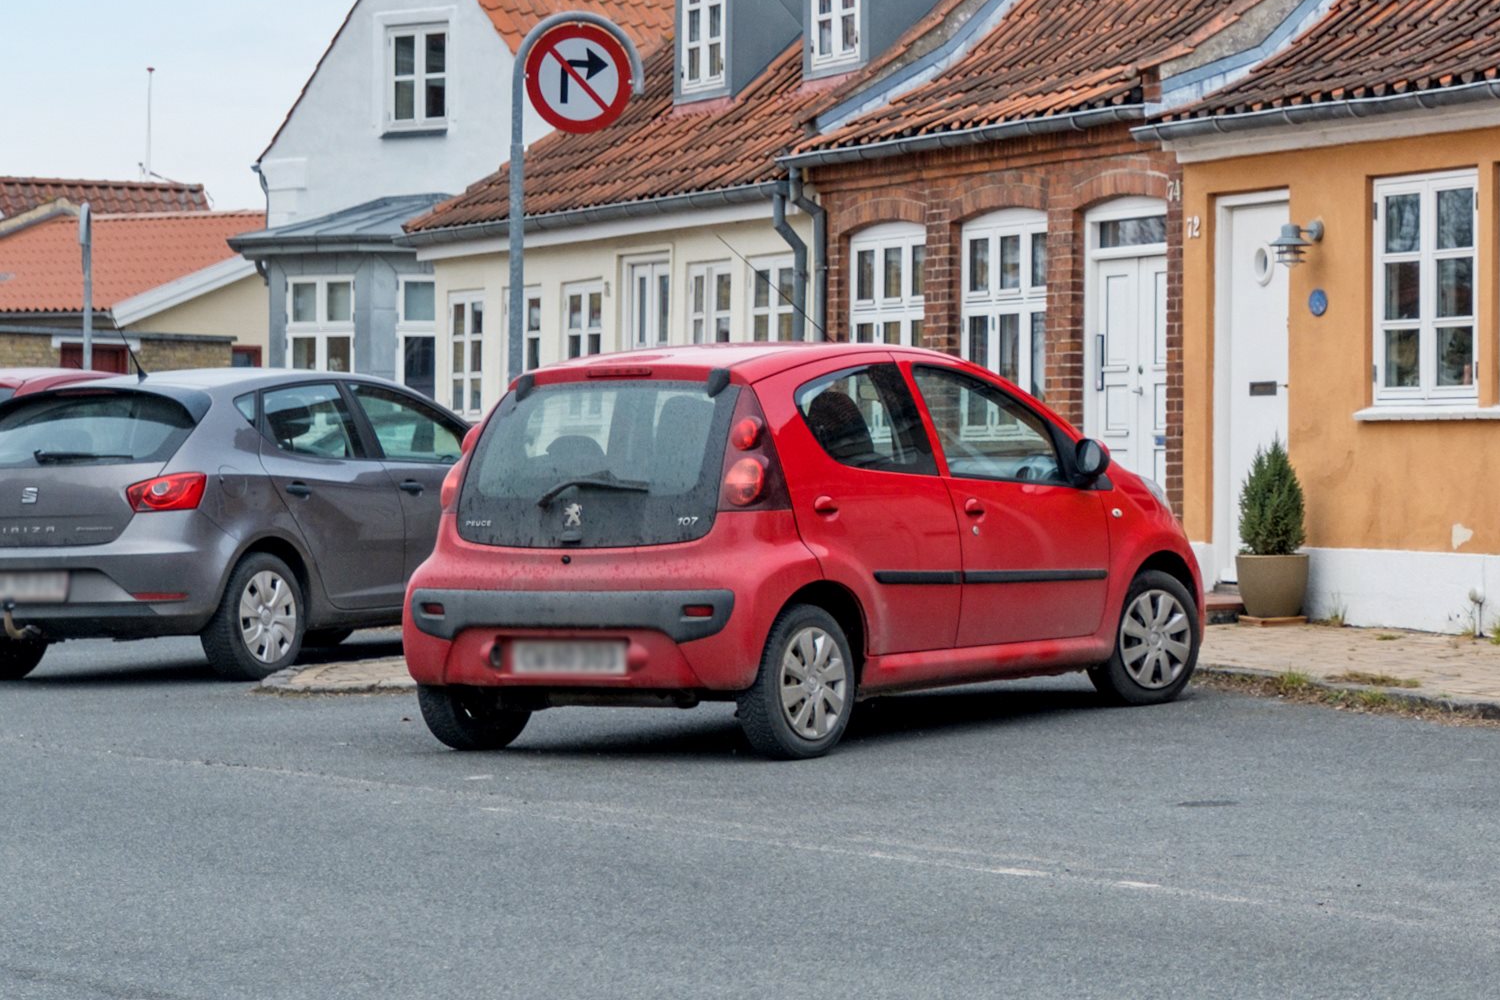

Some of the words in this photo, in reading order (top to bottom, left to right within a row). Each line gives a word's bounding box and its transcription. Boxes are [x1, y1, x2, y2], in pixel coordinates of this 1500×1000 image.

[1167, 179, 1180, 202] 74
[1186, 215, 1200, 239] 72
[677, 516, 699, 526] 107
